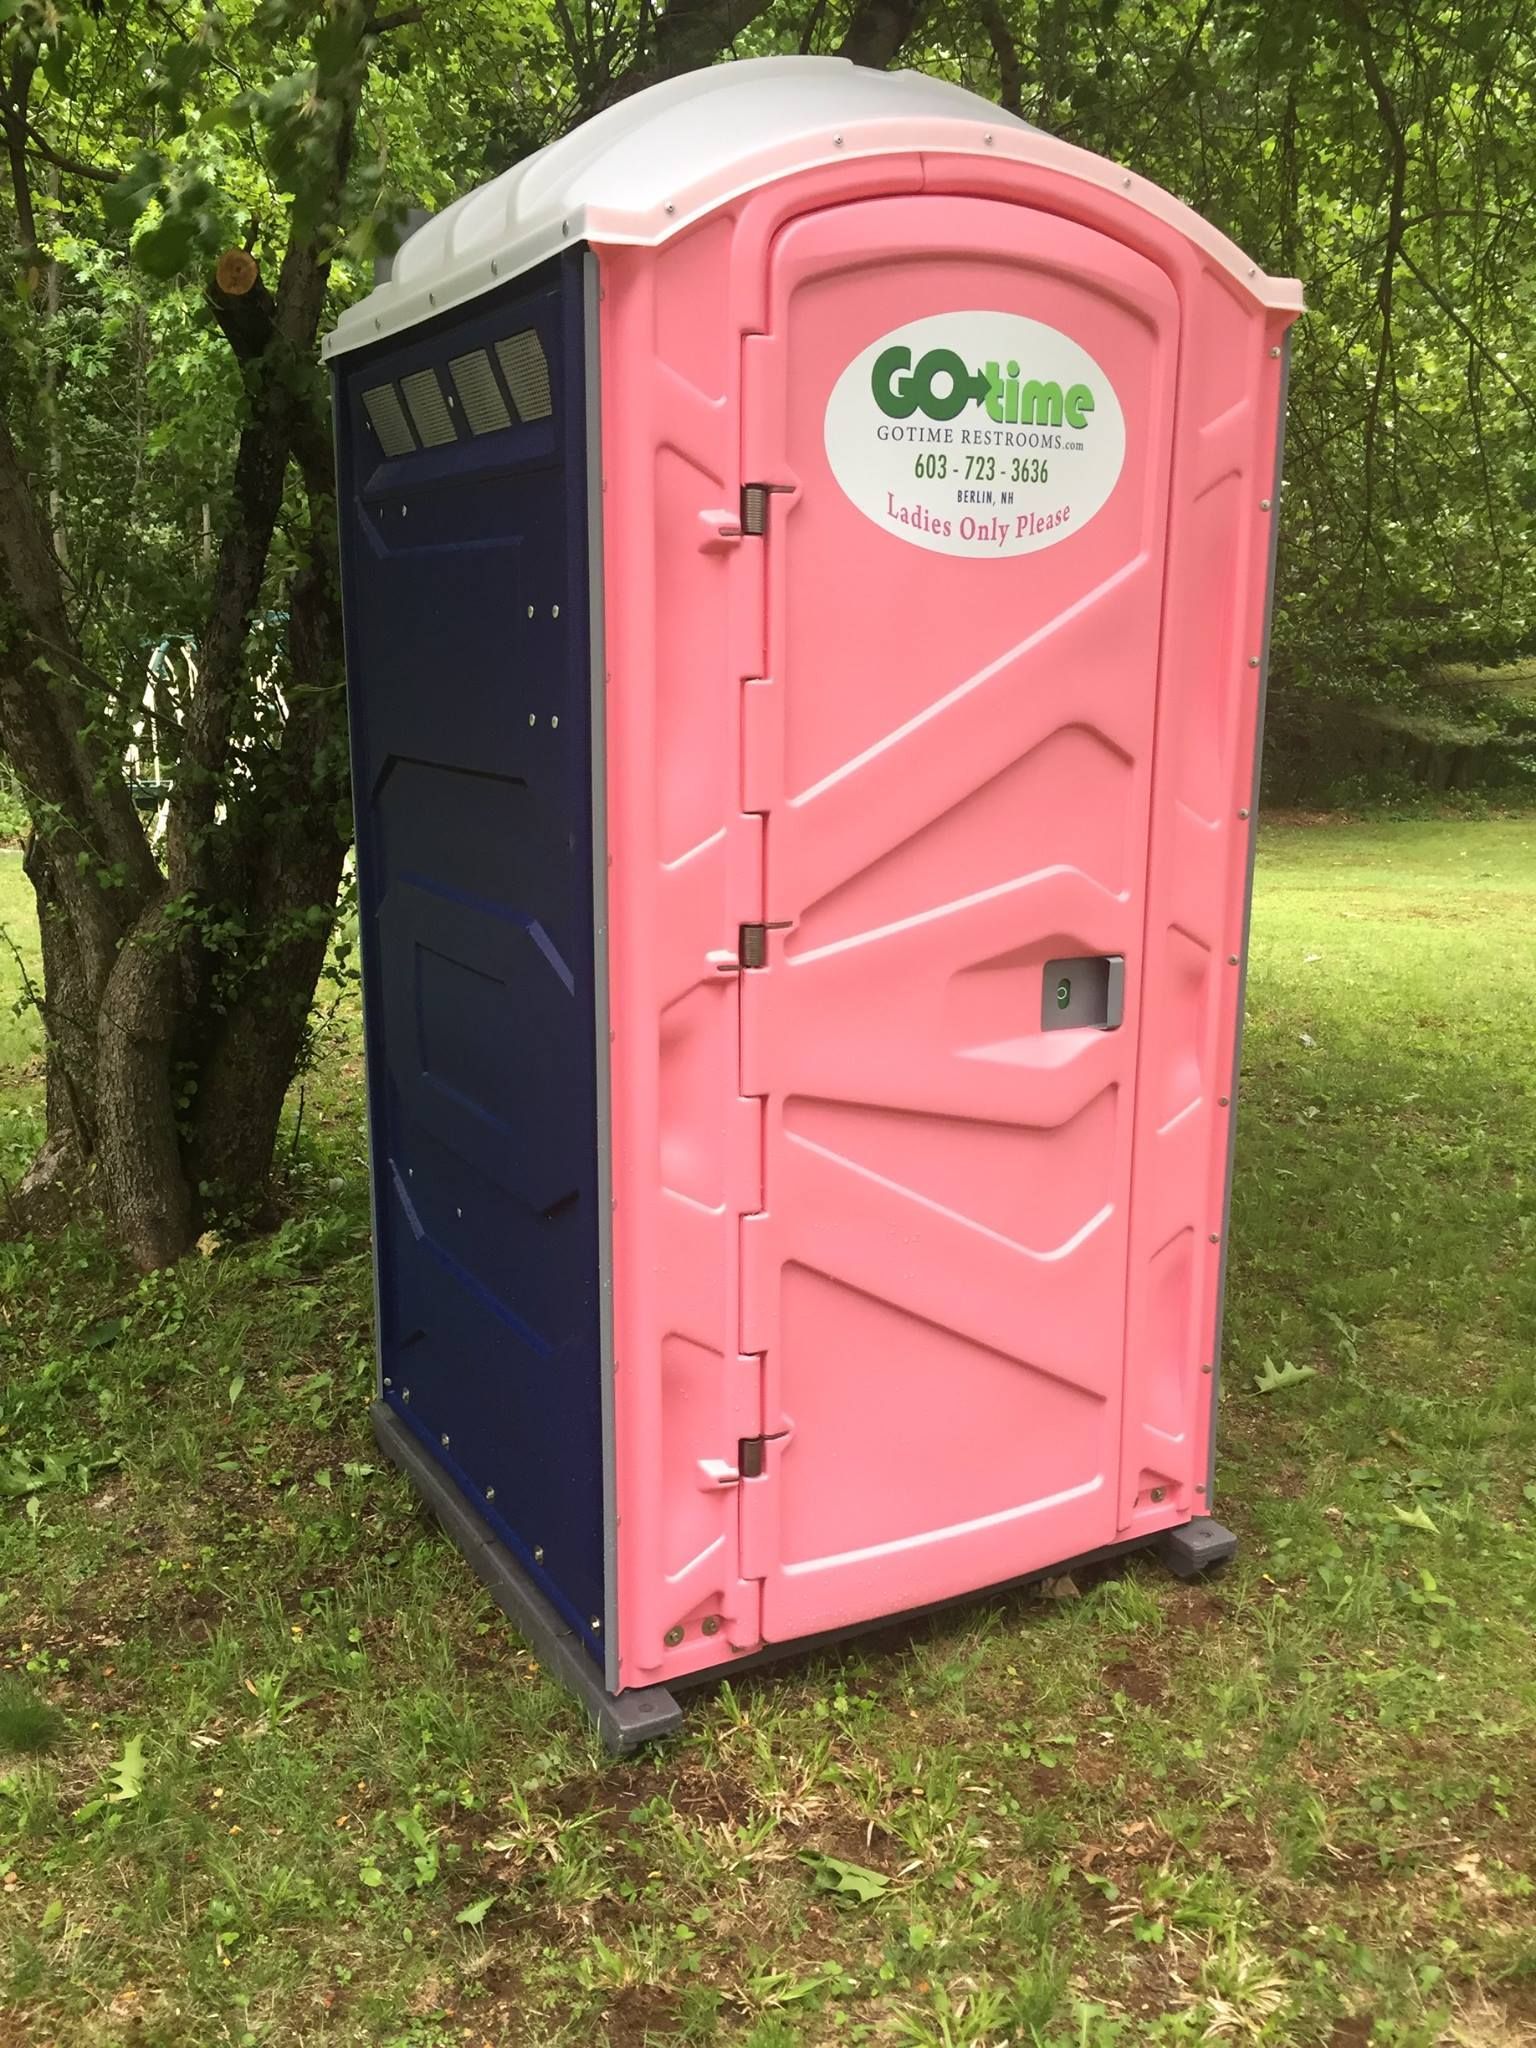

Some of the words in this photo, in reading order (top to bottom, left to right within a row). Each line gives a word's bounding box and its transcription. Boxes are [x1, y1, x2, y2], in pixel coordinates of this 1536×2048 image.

[877, 425, 953, 443] GOTIME
[914, 453, 947, 479] 603
[963, 455, 996, 481] 723
[1010, 457, 1049, 483] 3636
[956, 490, 996, 506] BERLIN,
[1000, 491, 1014, 504] NH
[886, 491, 952, 537] Ladies
[959, 516, 1010, 547] Only
[1015, 504, 1071, 539] Please
